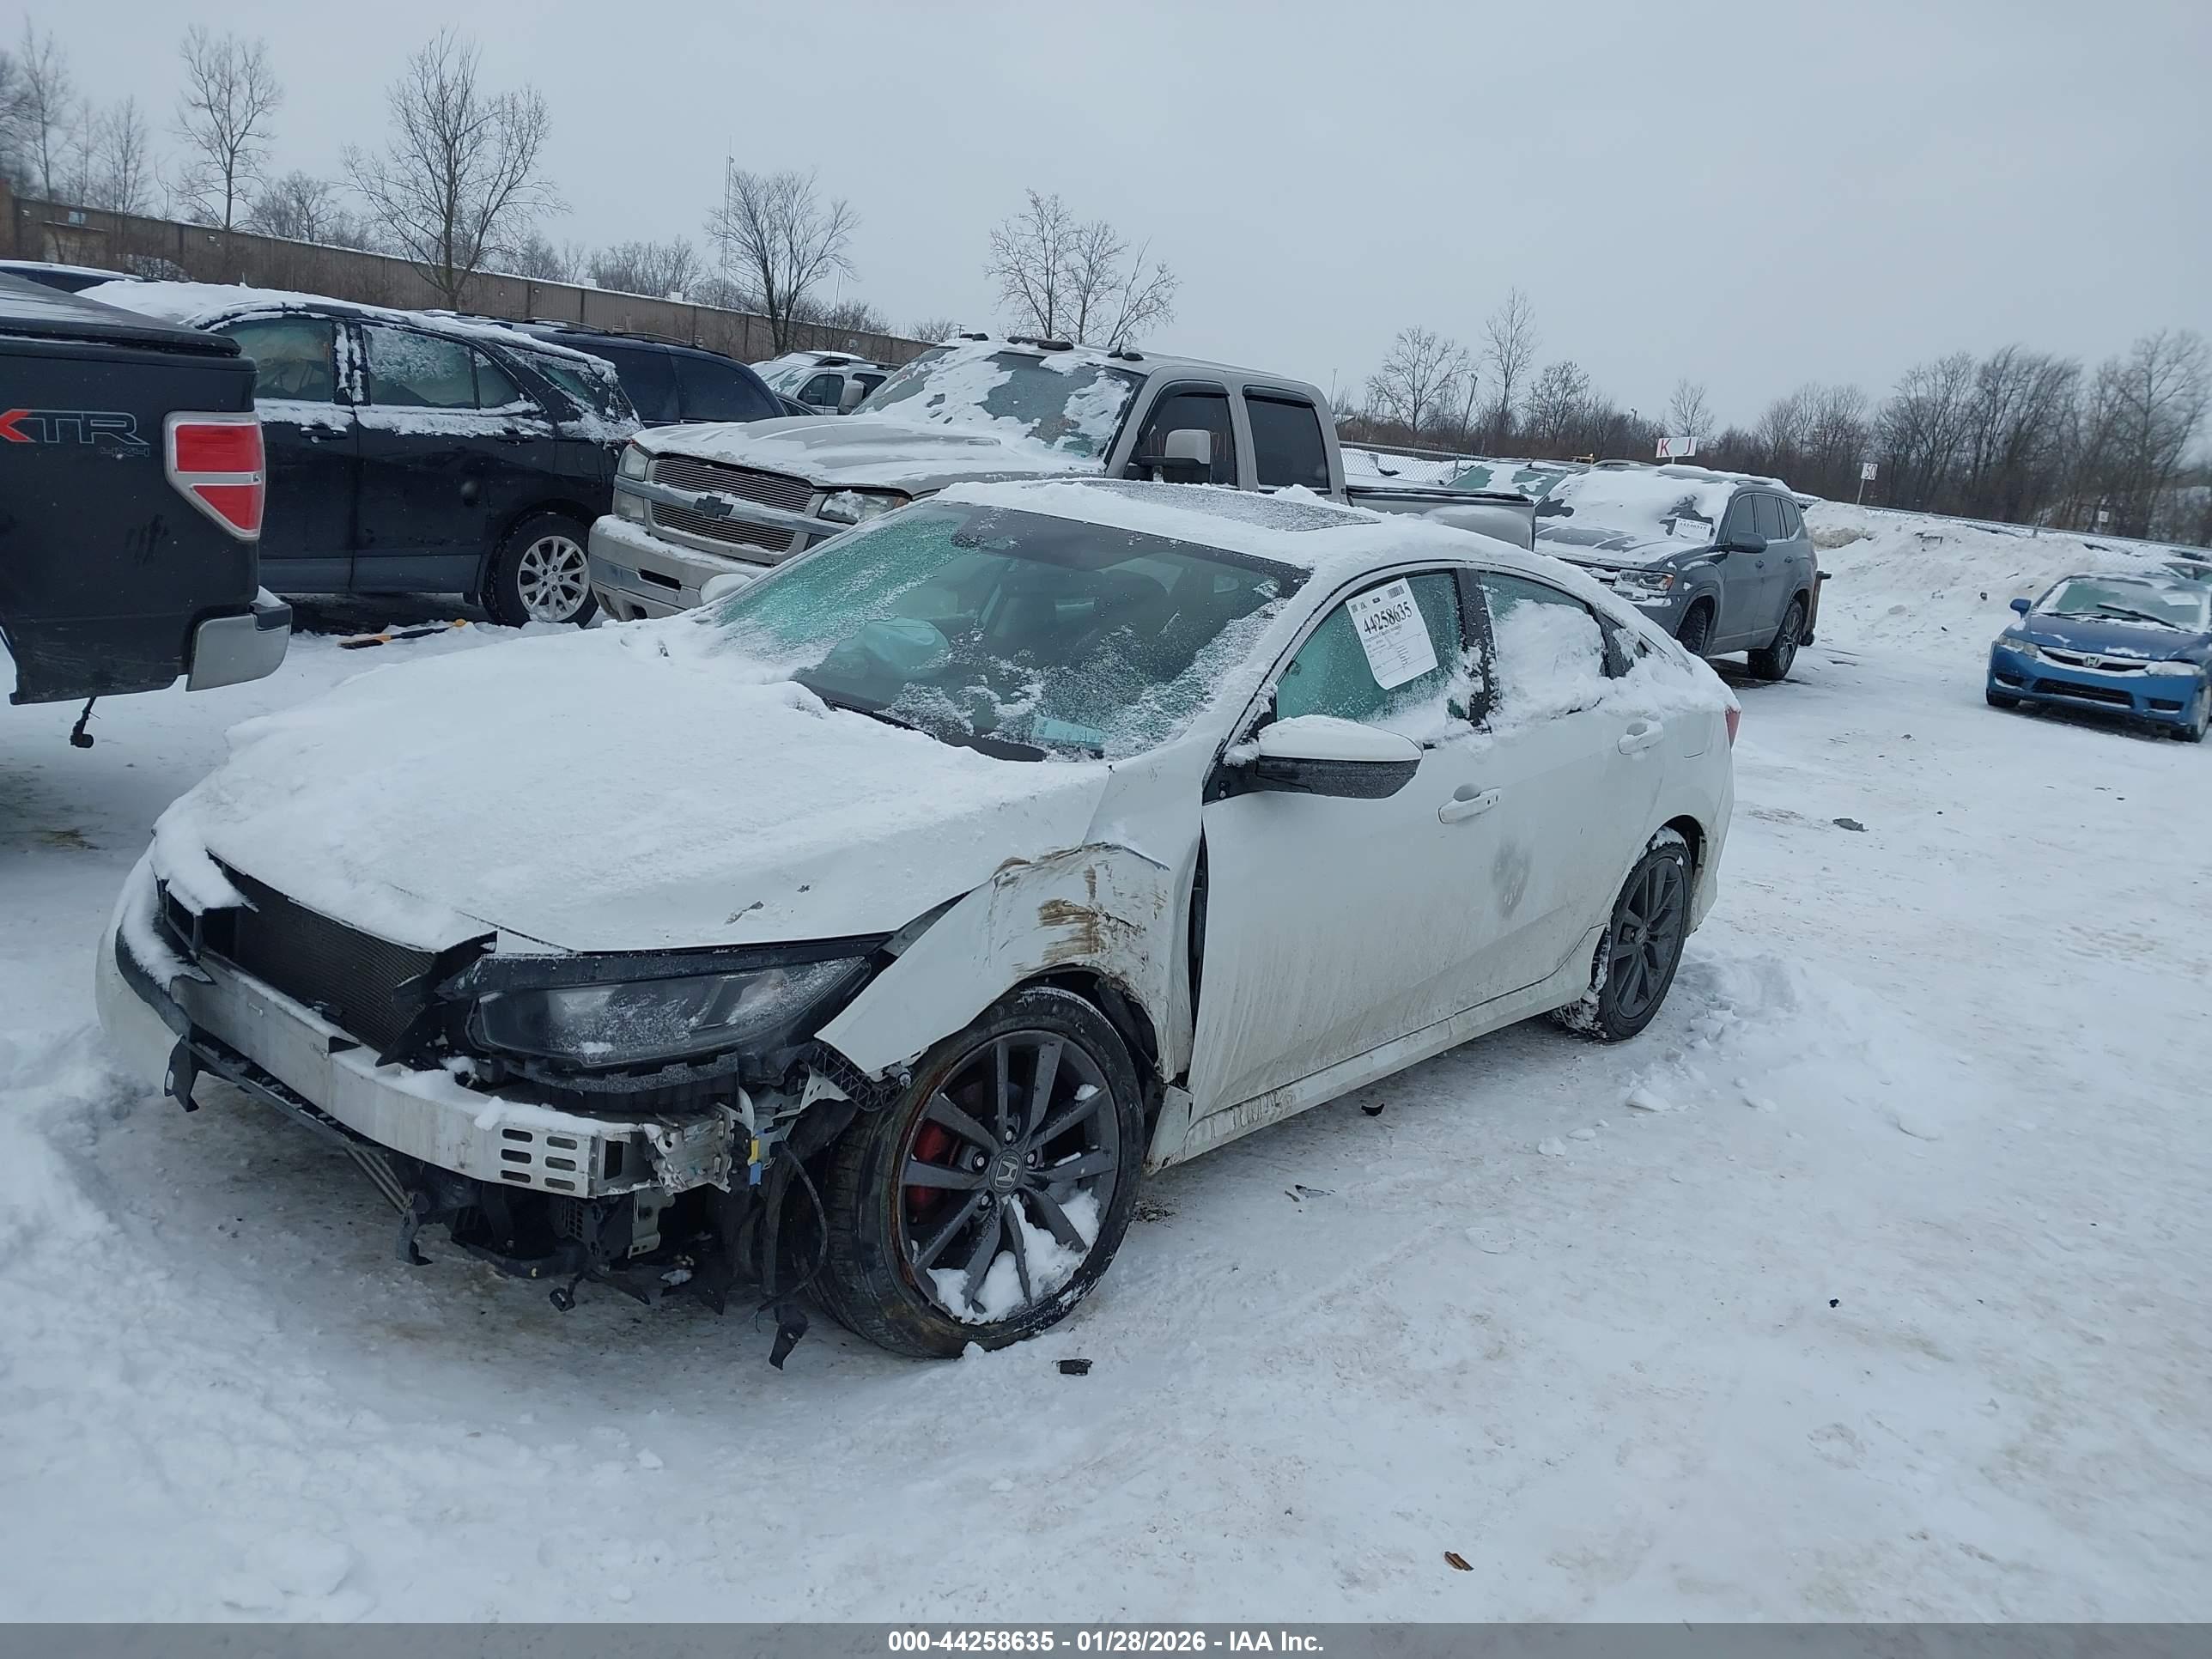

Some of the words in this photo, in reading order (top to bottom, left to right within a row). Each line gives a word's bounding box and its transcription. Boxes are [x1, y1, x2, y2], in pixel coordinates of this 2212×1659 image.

[1660, 439, 1672, 457] K
[1683, 438, 1691, 455] J
[1864, 465, 1876, 479] 50
[1364, 601, 1413, 635] 44258635
